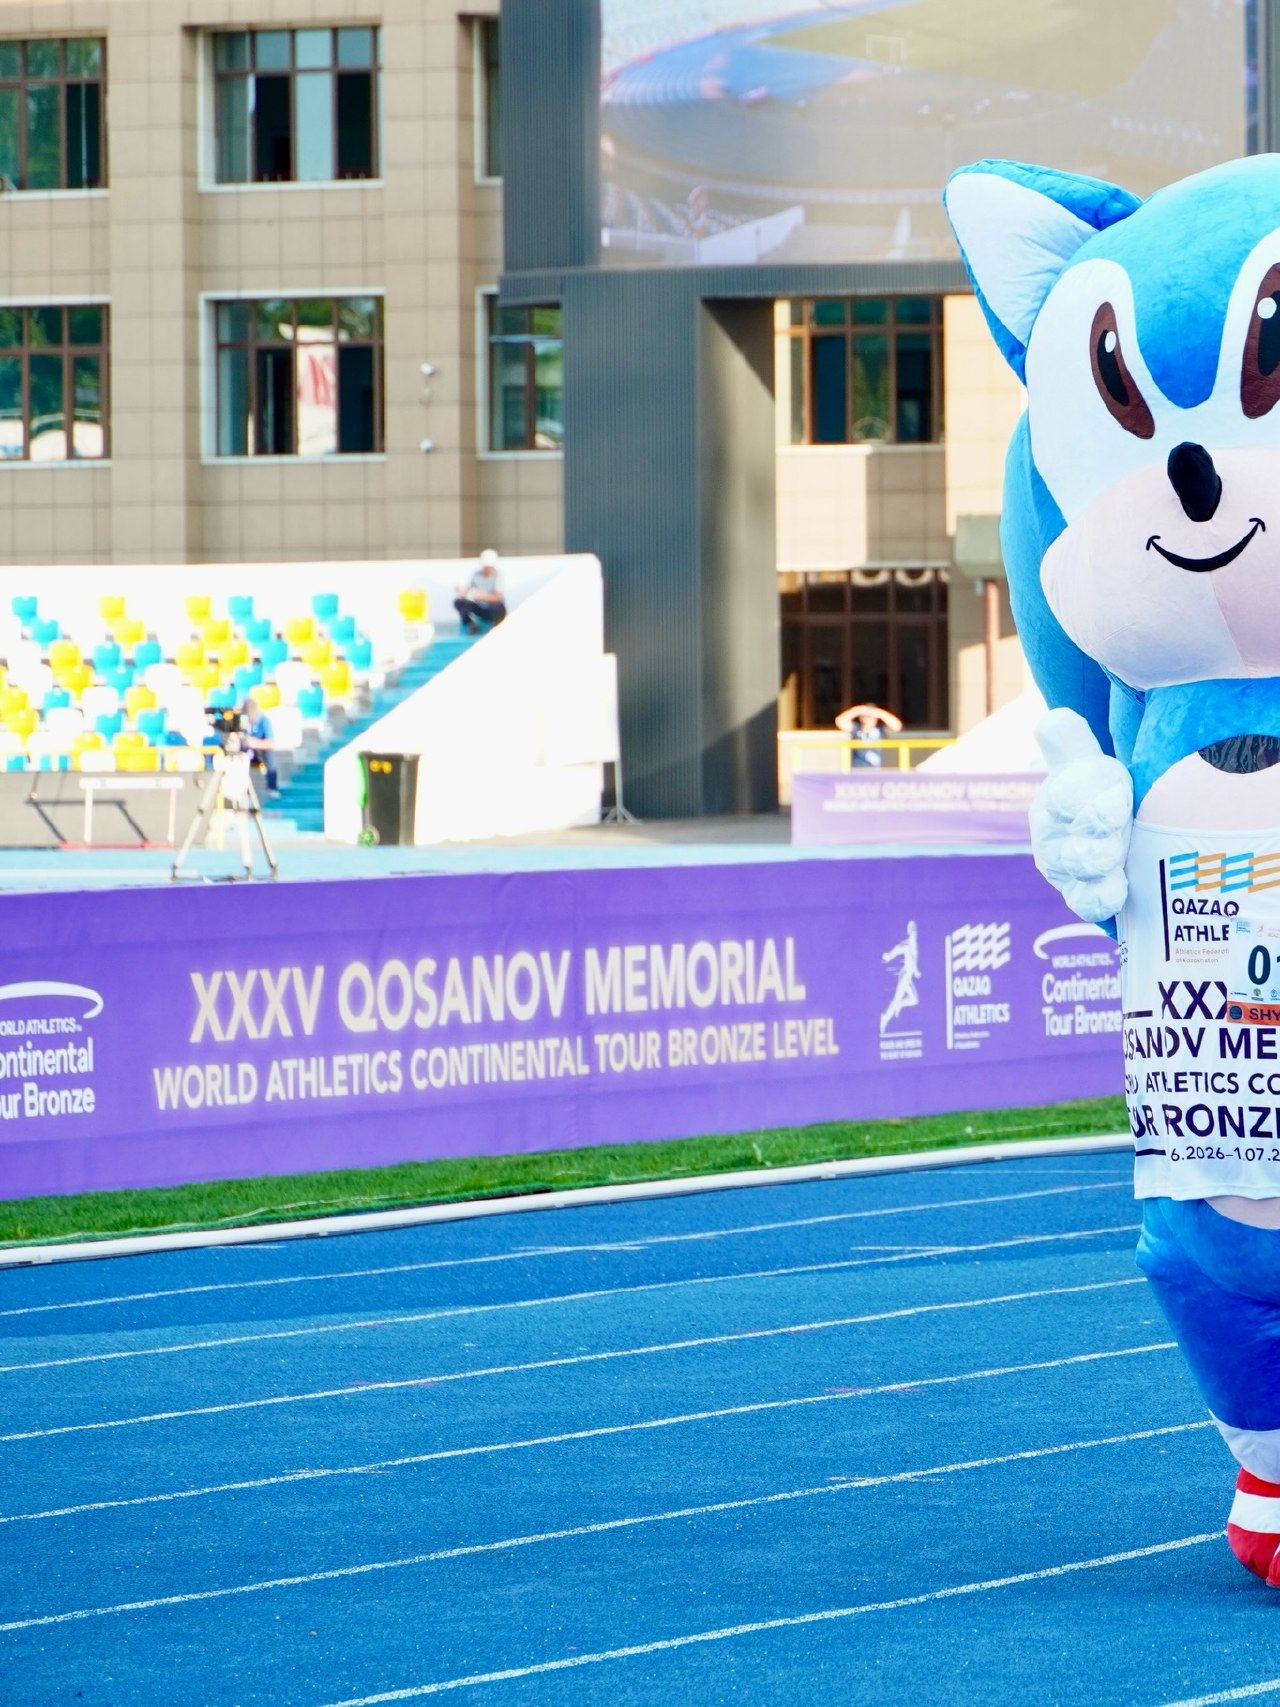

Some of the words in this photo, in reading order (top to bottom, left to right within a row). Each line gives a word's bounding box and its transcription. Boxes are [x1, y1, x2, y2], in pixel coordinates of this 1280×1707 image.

[1172, 898, 1239, 917] QAZAQ
[1174, 924, 1229, 941] ATHLE
[1202, 947, 1229, 955] Federati
[190, 965, 325, 1043] XXXV
[338, 950, 571, 1032] QOSANOV
[585, 937, 806, 1015] MEMORIAL
[1042, 972, 1121, 1004] Continental
[0, 1019, 24, 1036] ORLD
[26, 1017, 76, 1034] ATHLETICS
[953, 1003, 1010, 1026] ATHLETICS
[1042, 1007, 1073, 1036] Tour
[1075, 1006, 1122, 1033] Bronze
[0, 1036, 94, 1079] ontinental
[153, 1063, 258, 1110] WORLD
[265, 1050, 402, 1102] ATHLETICS
[410, 1036, 589, 1090] CONTINENTAL
[595, 1031, 661, 1073] TOUR
[668, 1022, 766, 1067] BRONZE
[774, 1018, 839, 1059] LEVEL
[0, 1093, 21, 1119] ur
[24, 1082, 95, 1117] Bronze
